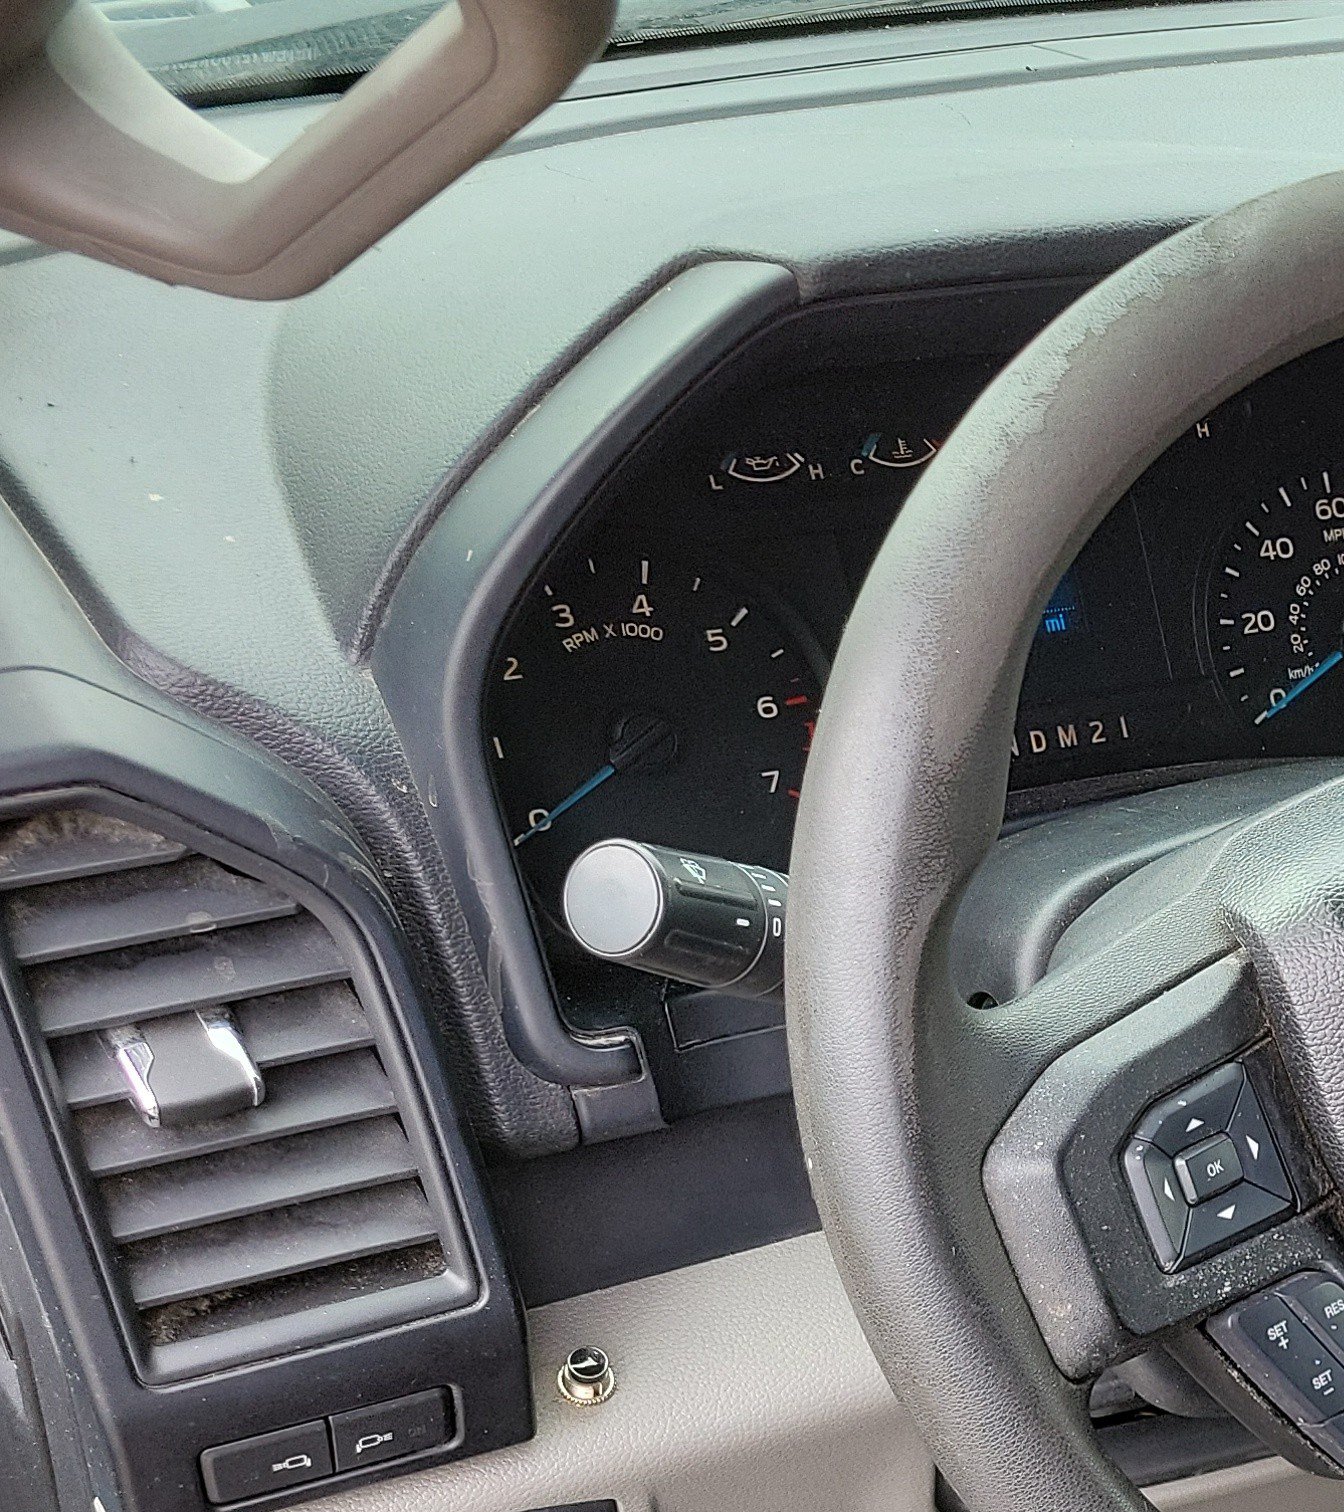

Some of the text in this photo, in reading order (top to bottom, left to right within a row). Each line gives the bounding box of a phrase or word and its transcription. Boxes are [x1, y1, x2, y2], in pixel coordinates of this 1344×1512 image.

[1196, 422, 1210, 439] H
[808, 463, 825, 480] H
[850, 459, 865, 475] C
[709, 474, 724, 490] L
[1259, 537, 1294, 560] 40
[1312, 558, 1331, 576] 80
[1296, 576, 1311, 596] 60
[551, 604, 575, 628] 3
[632, 594, 654, 617] 4
[1288, 603, 1300, 625] 40
[1045, 613, 1066, 633] mi
[1241, 610, 1275, 635] 20
[562, 627, 599, 652] RPM
[621, 622, 665, 641] 1000
[706, 628, 728, 651] 5
[1290, 634, 1304, 653] 20
[503, 657, 523, 681] 2
[757, 696, 778, 718] 6
[761, 770, 780, 793] 7
[528, 808, 552, 832] 0
[1206, 1159, 1225, 1177] OK
[1267, 1320, 1289, 1341] SET
[1311, 1369, 1333, 1390] SET
